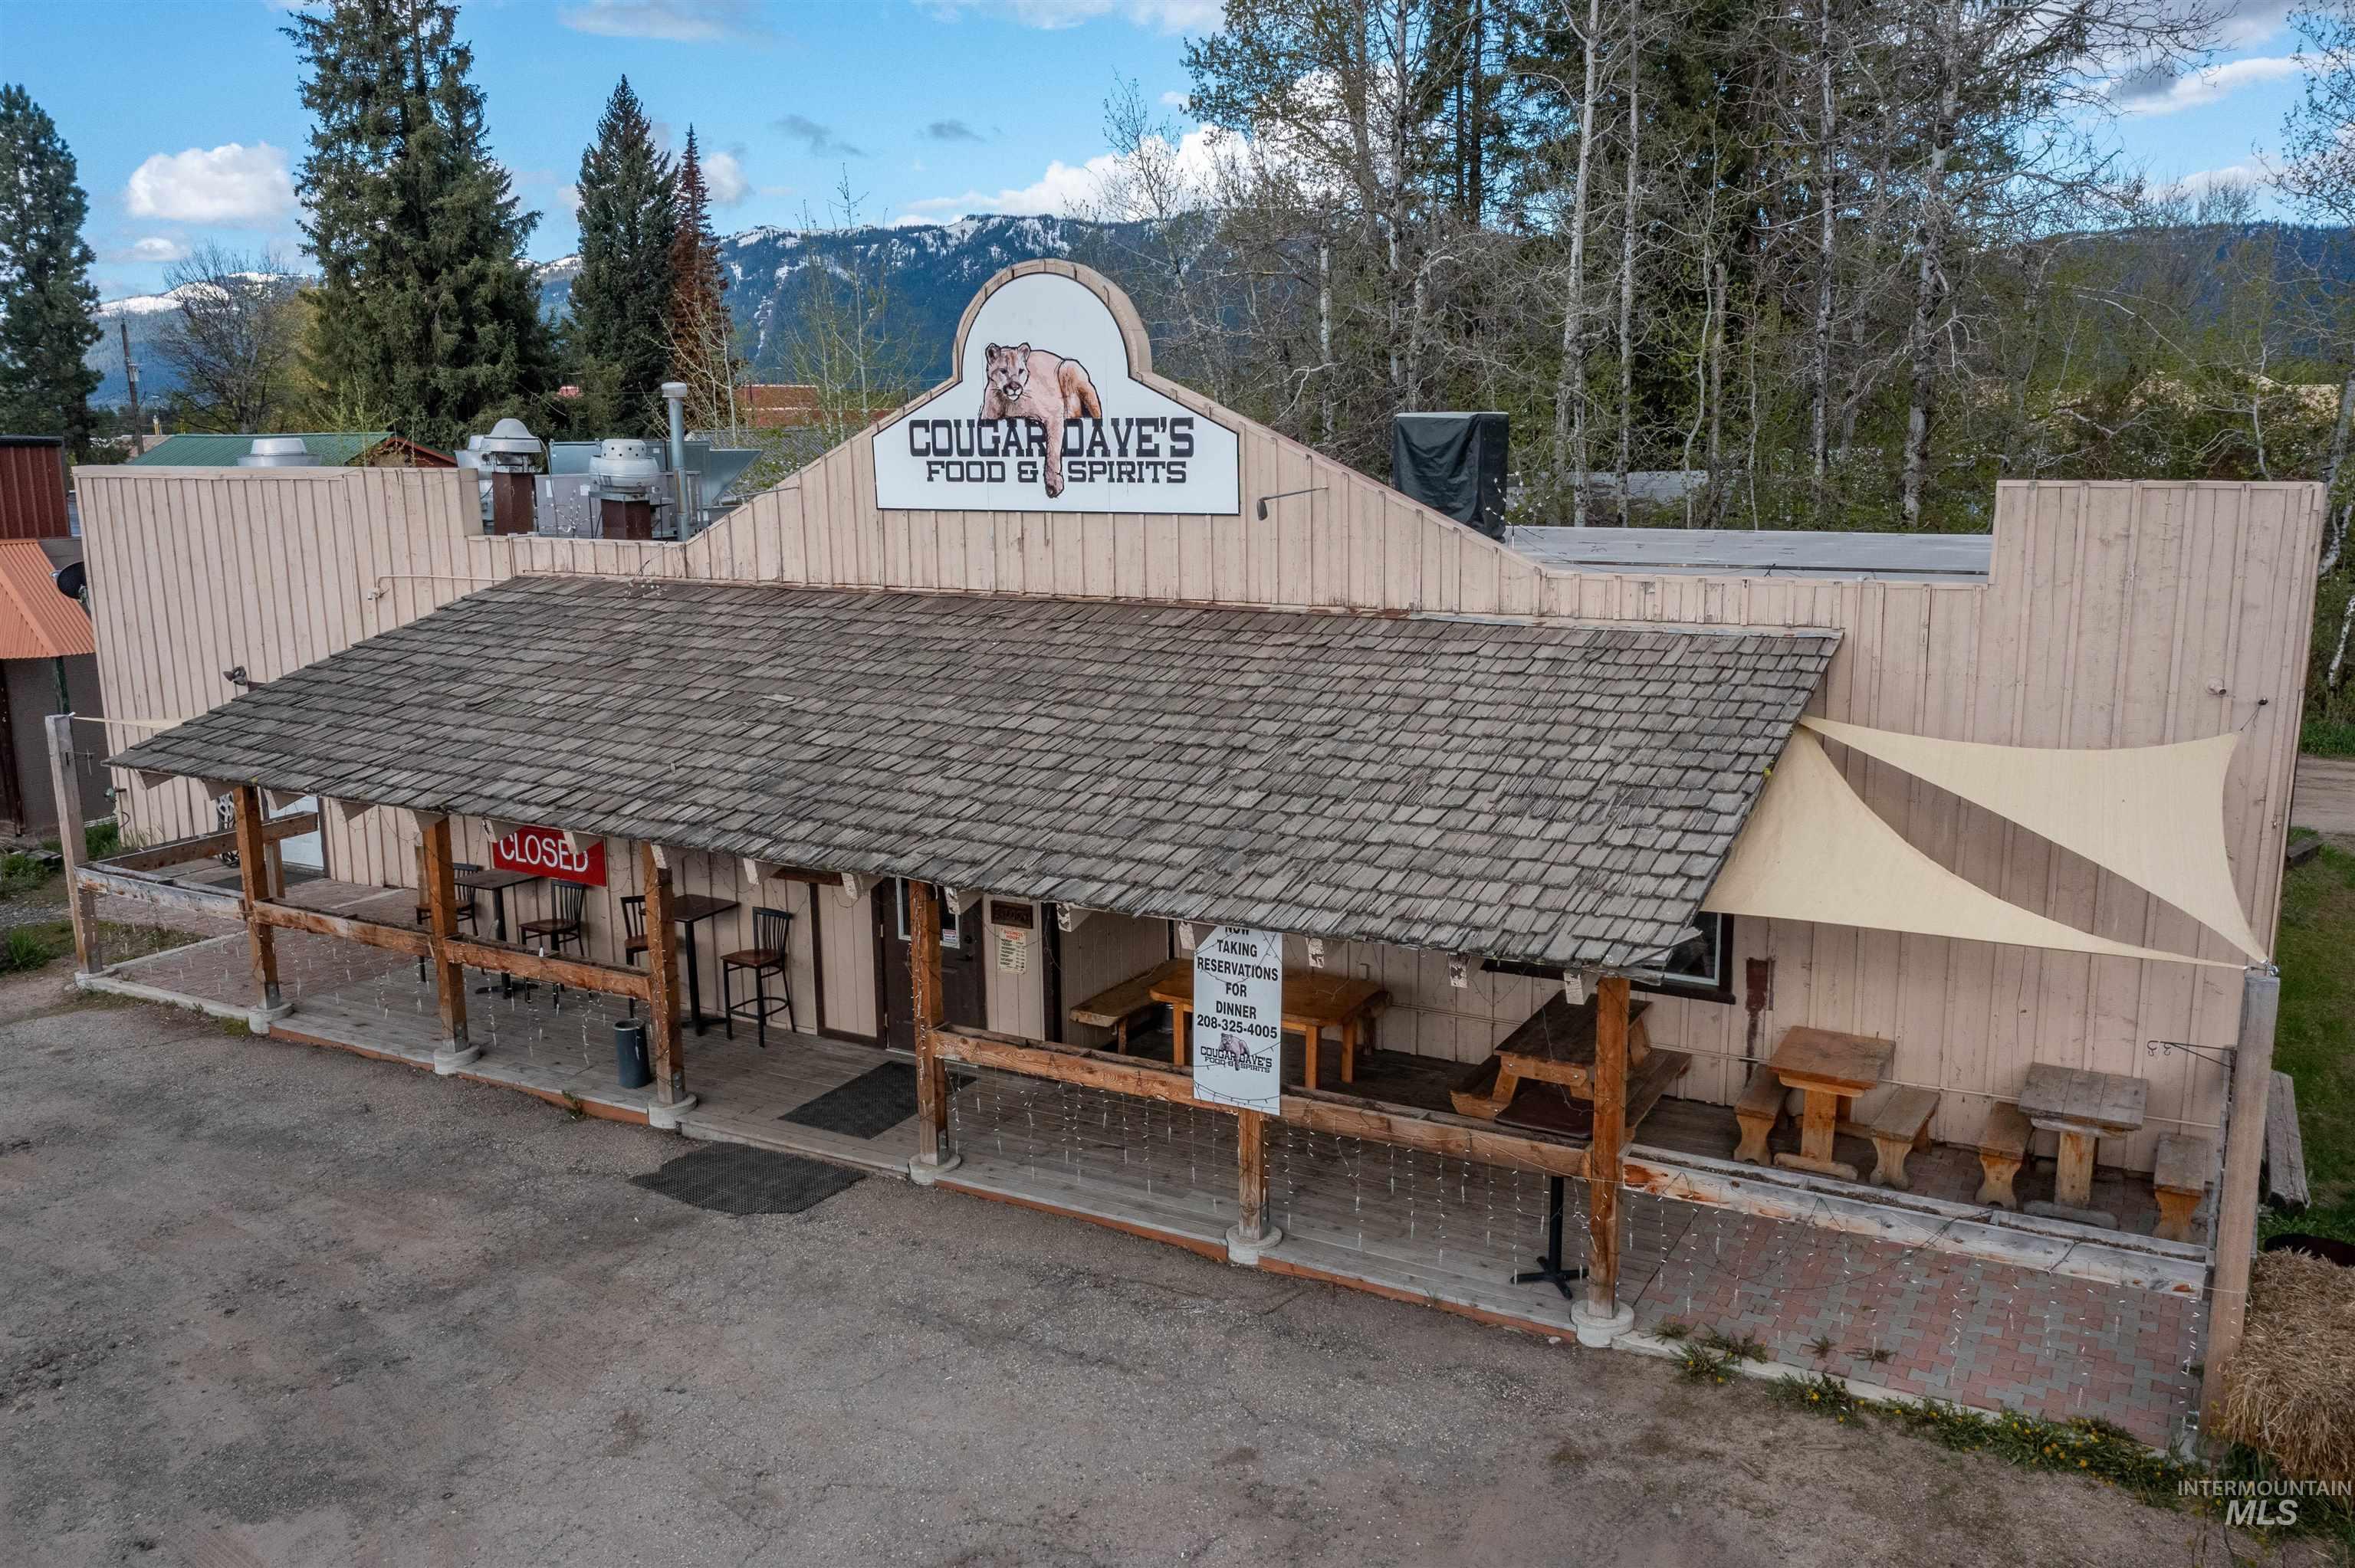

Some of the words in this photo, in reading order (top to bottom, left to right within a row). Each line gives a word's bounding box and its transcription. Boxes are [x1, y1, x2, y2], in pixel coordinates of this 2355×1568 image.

[909, 417, 1046, 458] COUGAR
[1061, 416, 1194, 458] DAVE'S
[926, 461, 1006, 483] FOOD
[1017, 461, 1039, 483] &
[1068, 461, 1187, 484] SPIRITS
[500, 832, 589, 872] CLOSED
[1217, 939, 1258, 958] TAKING
[1197, 956, 1279, 982] RESERVATIONS
[1226, 982, 1247, 997] FOR
[1216, 1000, 1257, 1020] DINNER
[1197, 1014, 1278, 1039] 208-325-4005
[1200, 1045, 1237, 1062] COUGAR
[1239, 1053, 1273, 1068] DAVE'S
[1204, 1056, 1227, 1066] FOOD
[1240, 1063, 1270, 1074] SPIRITS
